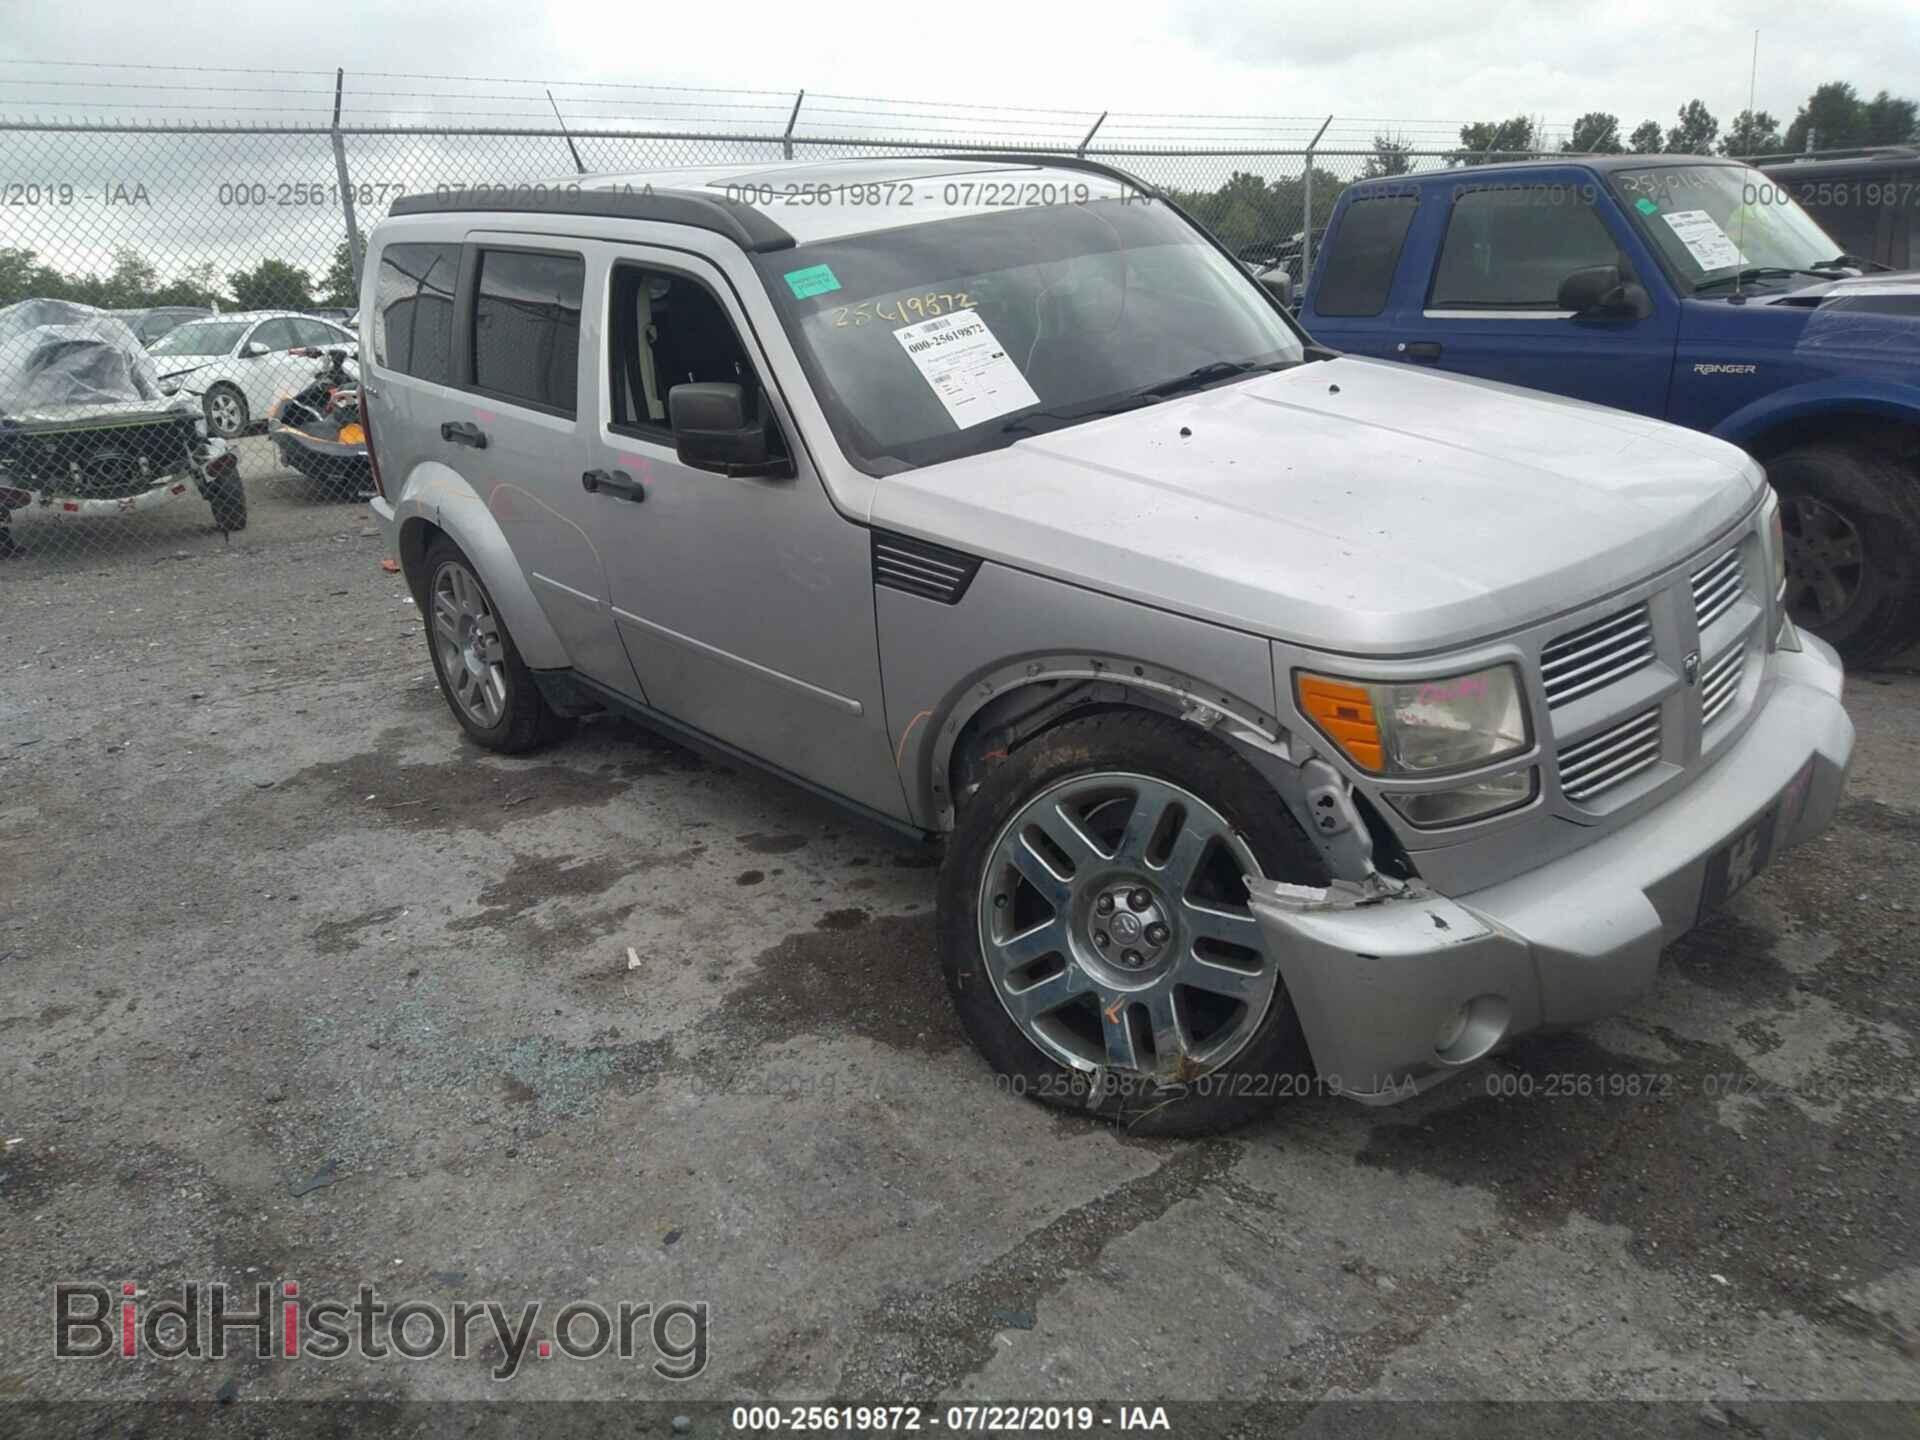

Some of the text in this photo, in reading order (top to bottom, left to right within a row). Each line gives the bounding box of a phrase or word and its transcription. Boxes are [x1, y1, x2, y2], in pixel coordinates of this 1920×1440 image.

[836, 292, 979, 327] 25619872
[908, 323, 985, 353] 000-25619872
[1693, 363, 1757, 376] RANGER
